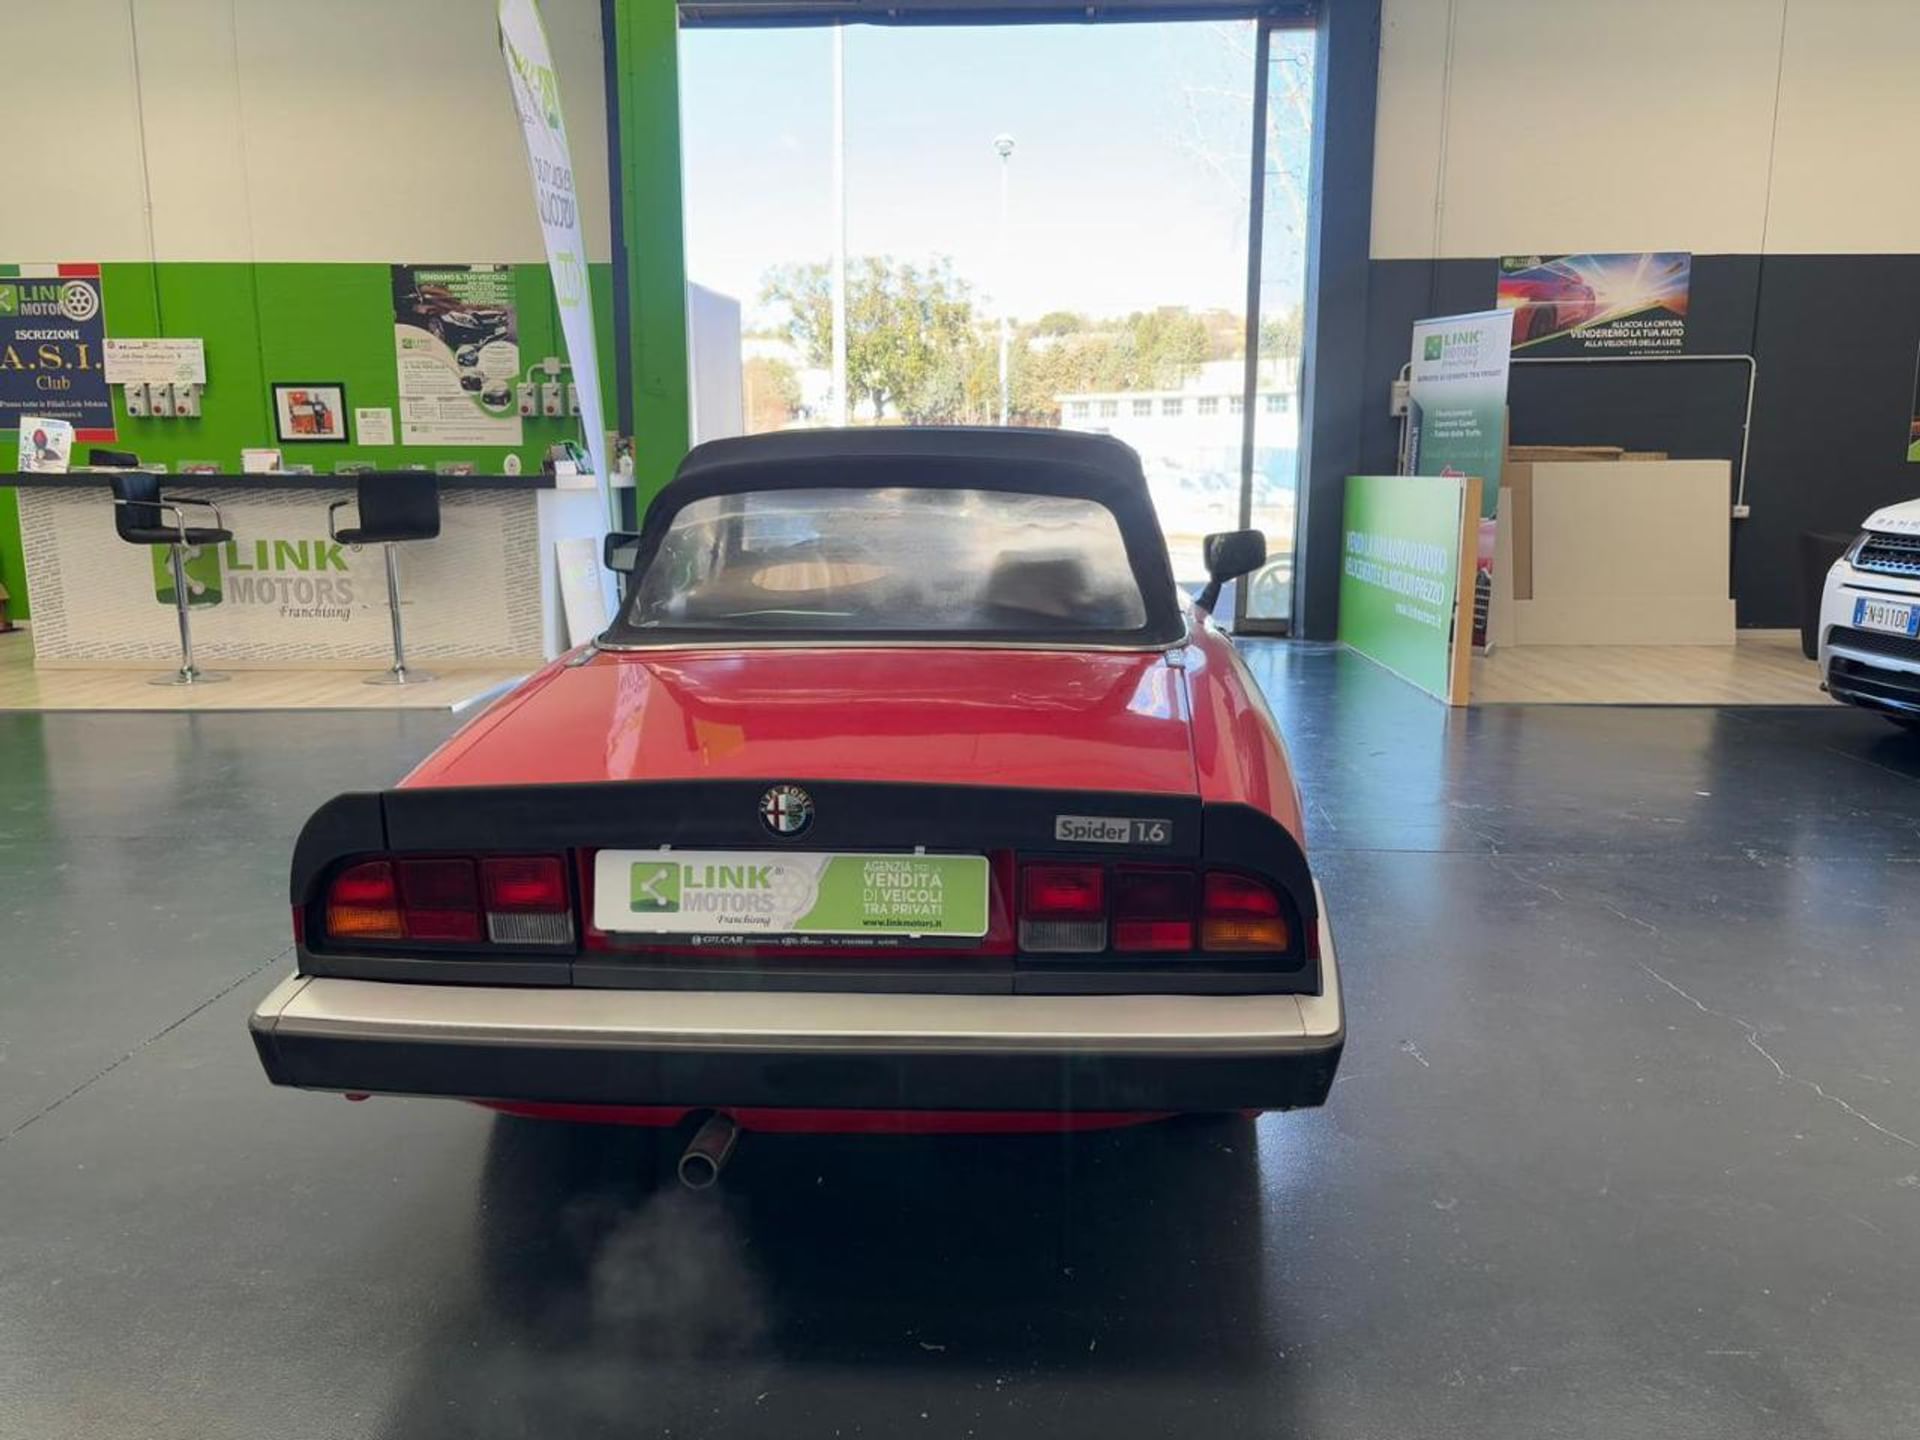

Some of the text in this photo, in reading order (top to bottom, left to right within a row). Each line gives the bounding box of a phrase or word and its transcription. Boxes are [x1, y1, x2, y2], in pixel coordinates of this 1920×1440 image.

[15, 330, 79, 340] ISCRIZIONI
[1444, 331, 1482, 346] LINK
[1570, 328, 1684, 338] VENDEREMO LA TUA AUTO
[0, 344, 101, 369] A.S.I.
[36, 375, 71, 390] Club
[225, 540, 349, 571] LINK
[228, 576, 354, 605] MOTORS
[280, 604, 352, 622] Franchising
[1062, 820, 1164, 841] Spider 1.6
[863, 861, 912, 873] AGENZIA
[683, 865, 771, 889] LINK
[863, 873, 943, 888] VENDITA
[683, 892, 775, 913] MOTORS
[863, 889, 943, 903] DI VEICOLI
[864, 904, 942, 916] TRA PRIVATI
